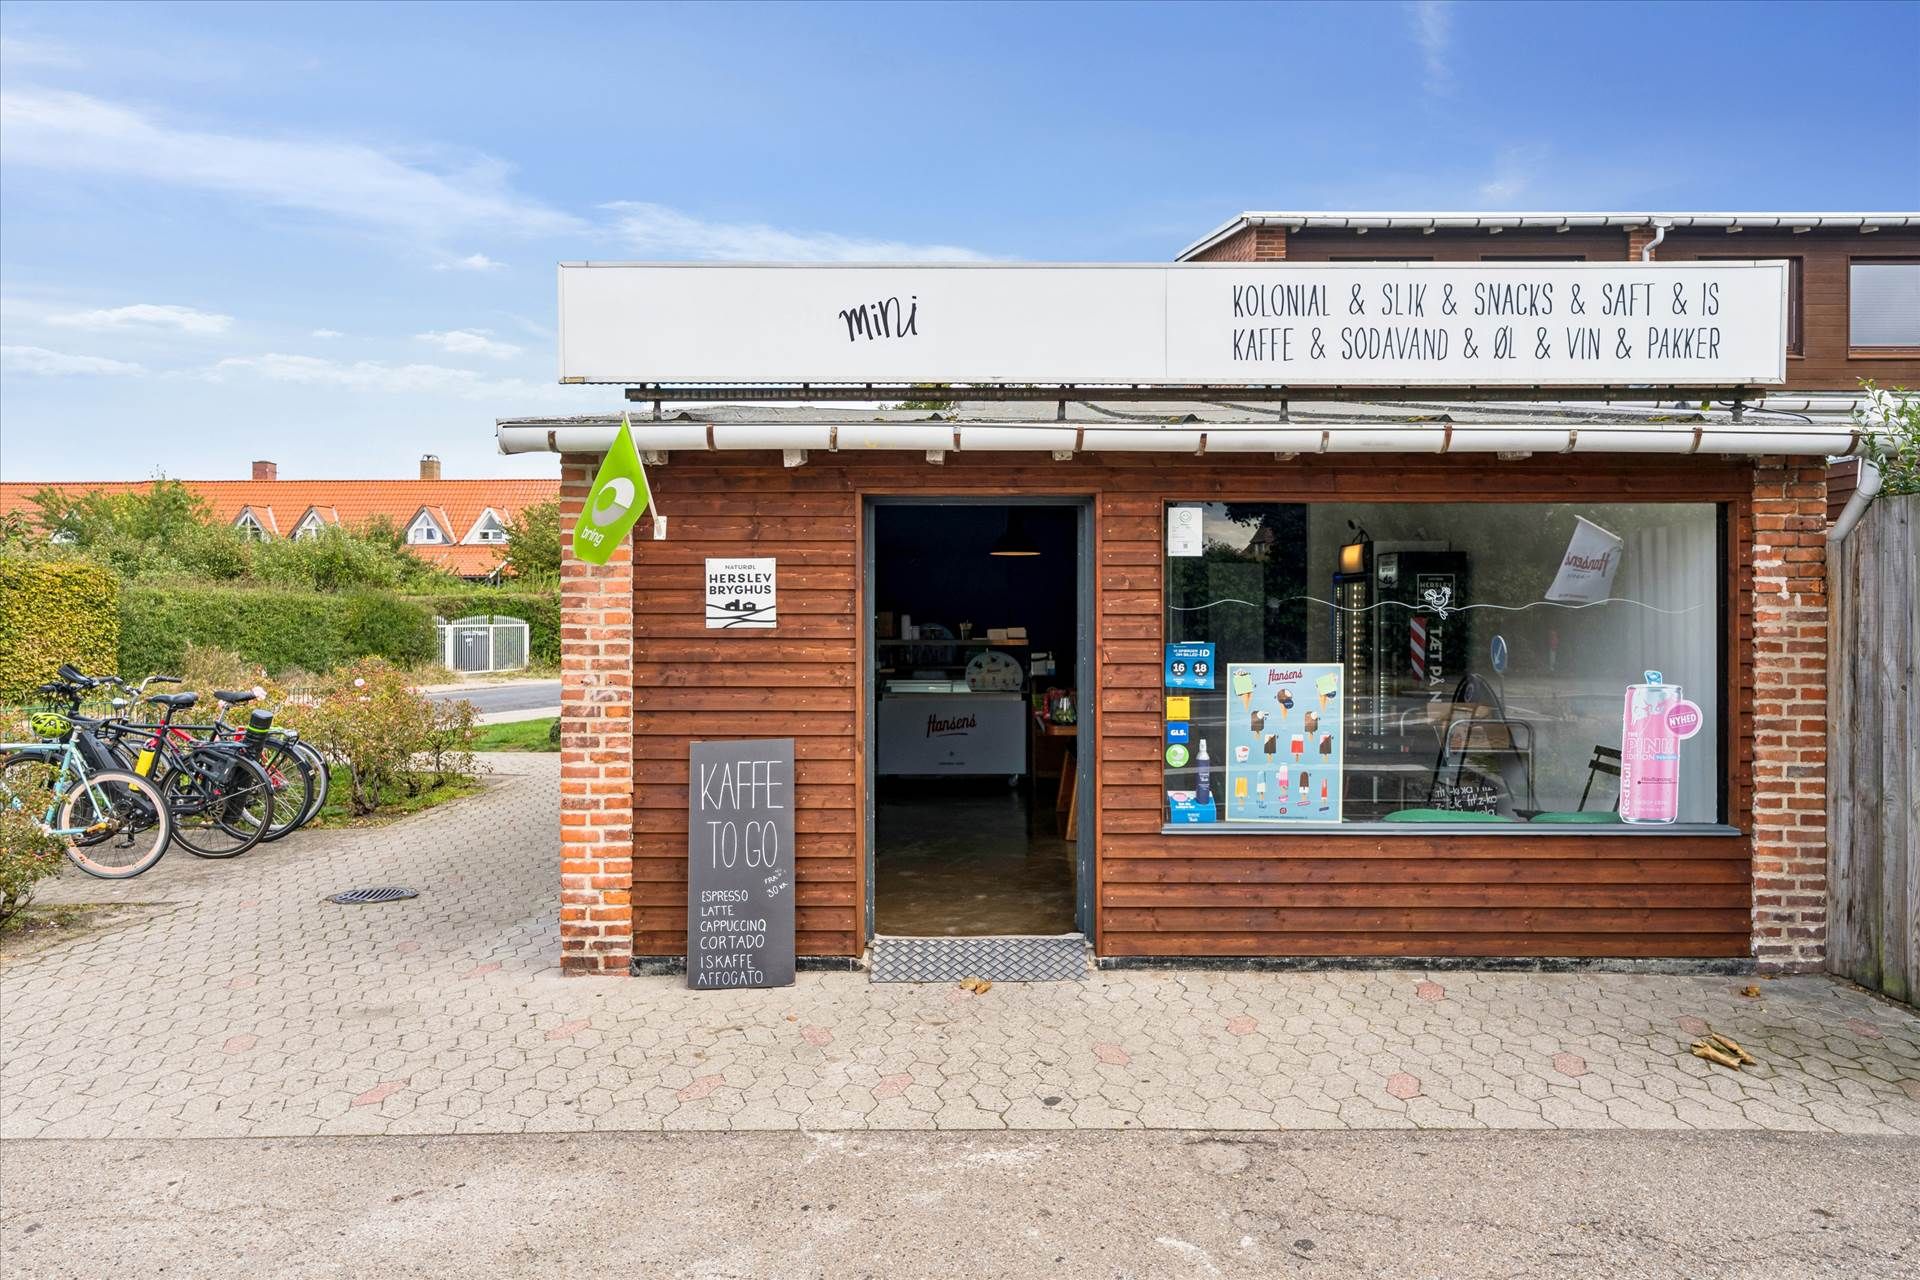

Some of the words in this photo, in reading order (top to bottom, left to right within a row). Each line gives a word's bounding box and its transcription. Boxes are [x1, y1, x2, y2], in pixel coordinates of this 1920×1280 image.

[1233, 284, 1330, 317] KOLONIAL
[1349, 284, 1365, 315] &
[1382, 283, 1427, 317] SLIK
[1442, 283, 1457, 315] &
[1474, 283, 1553, 317] SNACKS
[1571, 283, 1586, 315] &
[1602, 283, 1655, 317] SAFT
[1672, 283, 1688, 315] &
[1702, 283, 1719, 317] IS
[838, 295, 918, 342] mini
[1233, 327, 1294, 361] KAFFE
[1310, 327, 1326, 359] &
[1341, 327, 1449, 361] SODAVAND
[1463, 327, 1479, 359] &
[1493, 325, 1517, 360] ØL
[1535, 327, 1551, 359] &
[1567, 327, 1600, 360] VIN
[1615, 327, 1632, 360] &
[1648, 327, 1721, 360] PAKKER
[581, 526, 604, 547] bring
[709, 573, 772, 584] HERSLEV
[709, 585, 772, 595] BRYGHUS
[1173, 663, 1185, 672] 16
[1194, 663, 1207, 673] 18
[1429, 666, 1446, 687] PÅ
[1669, 713, 1697, 727] NYHED
[701, 760, 784, 811] KAFFE
[706, 821, 738, 869] TO
[745, 820, 778, 868] GO
[701, 889, 749, 902] ESPRESSO
[766, 885, 779, 898] 30
[701, 904, 735, 917] LATTE
[700, 918, 767, 933] CAPPUCCINO
[700, 934, 765, 950] CORTADO
[700, 953, 755, 970] ISKAFFE
[697, 970, 763, 986] AFFOGATO
